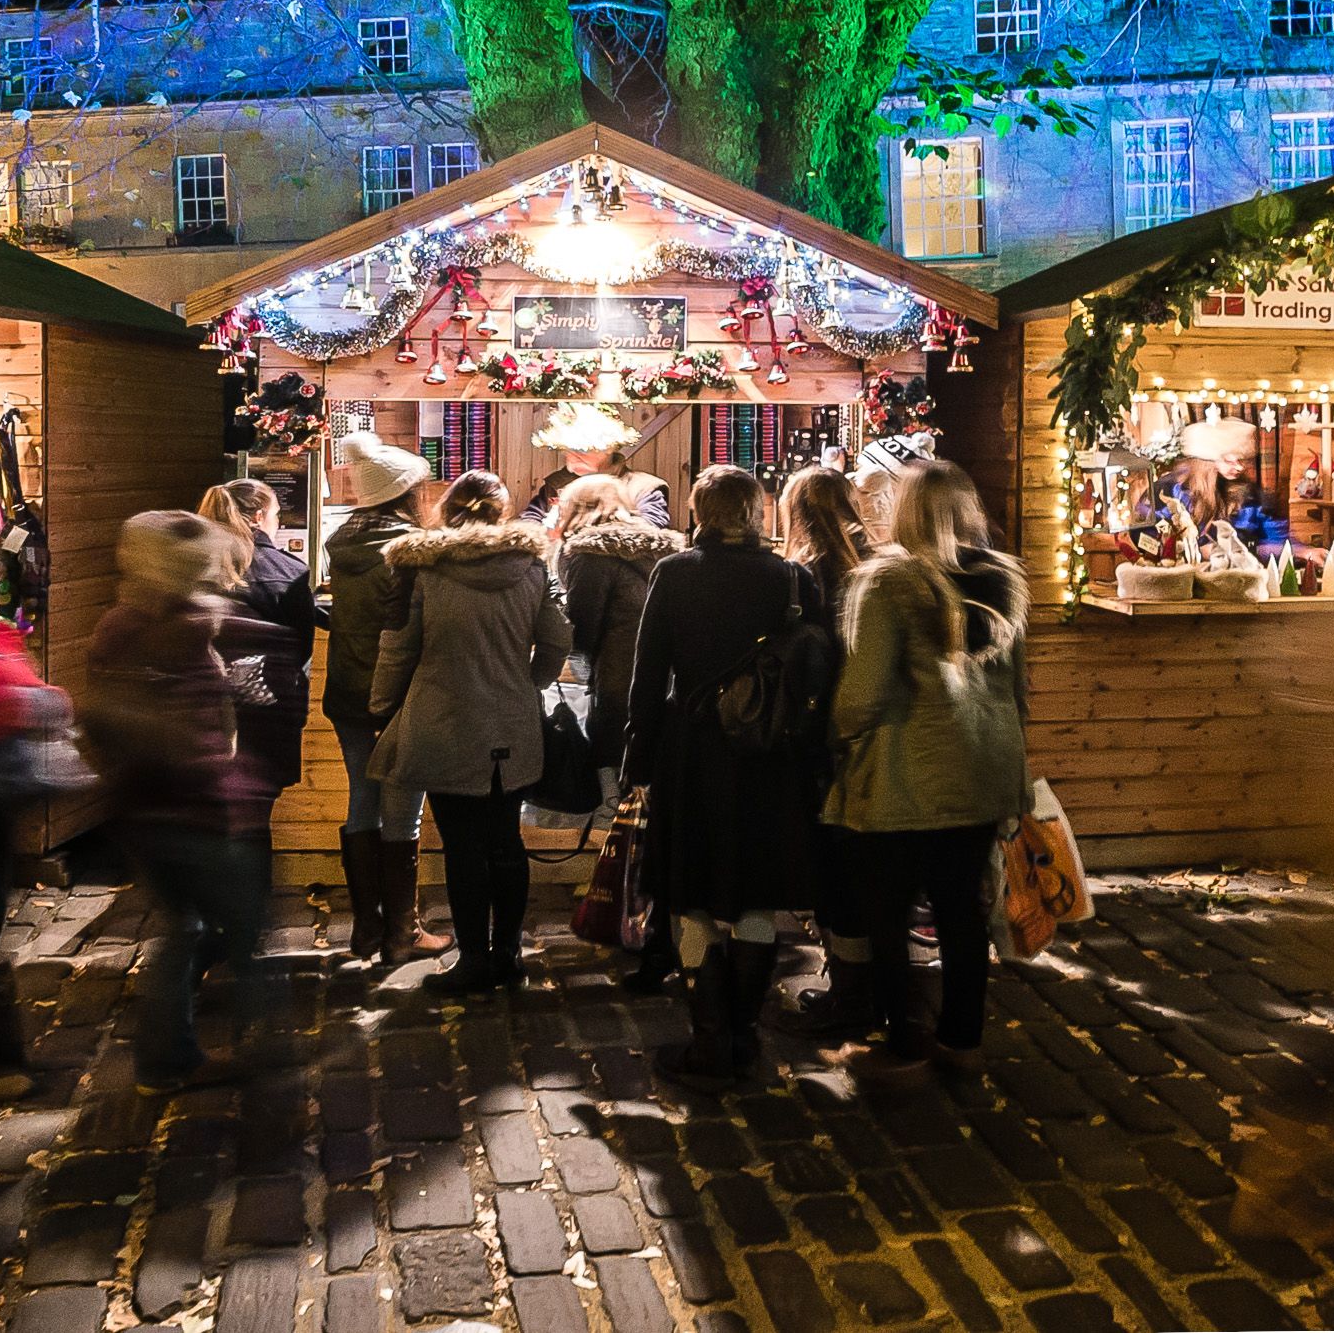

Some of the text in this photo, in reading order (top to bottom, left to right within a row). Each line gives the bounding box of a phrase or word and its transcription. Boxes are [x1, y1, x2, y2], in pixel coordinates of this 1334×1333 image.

[1253, 301, 1332, 322] Trading
[540, 313, 599, 331] Simply
[599, 333, 679, 349] Sprinkle!
